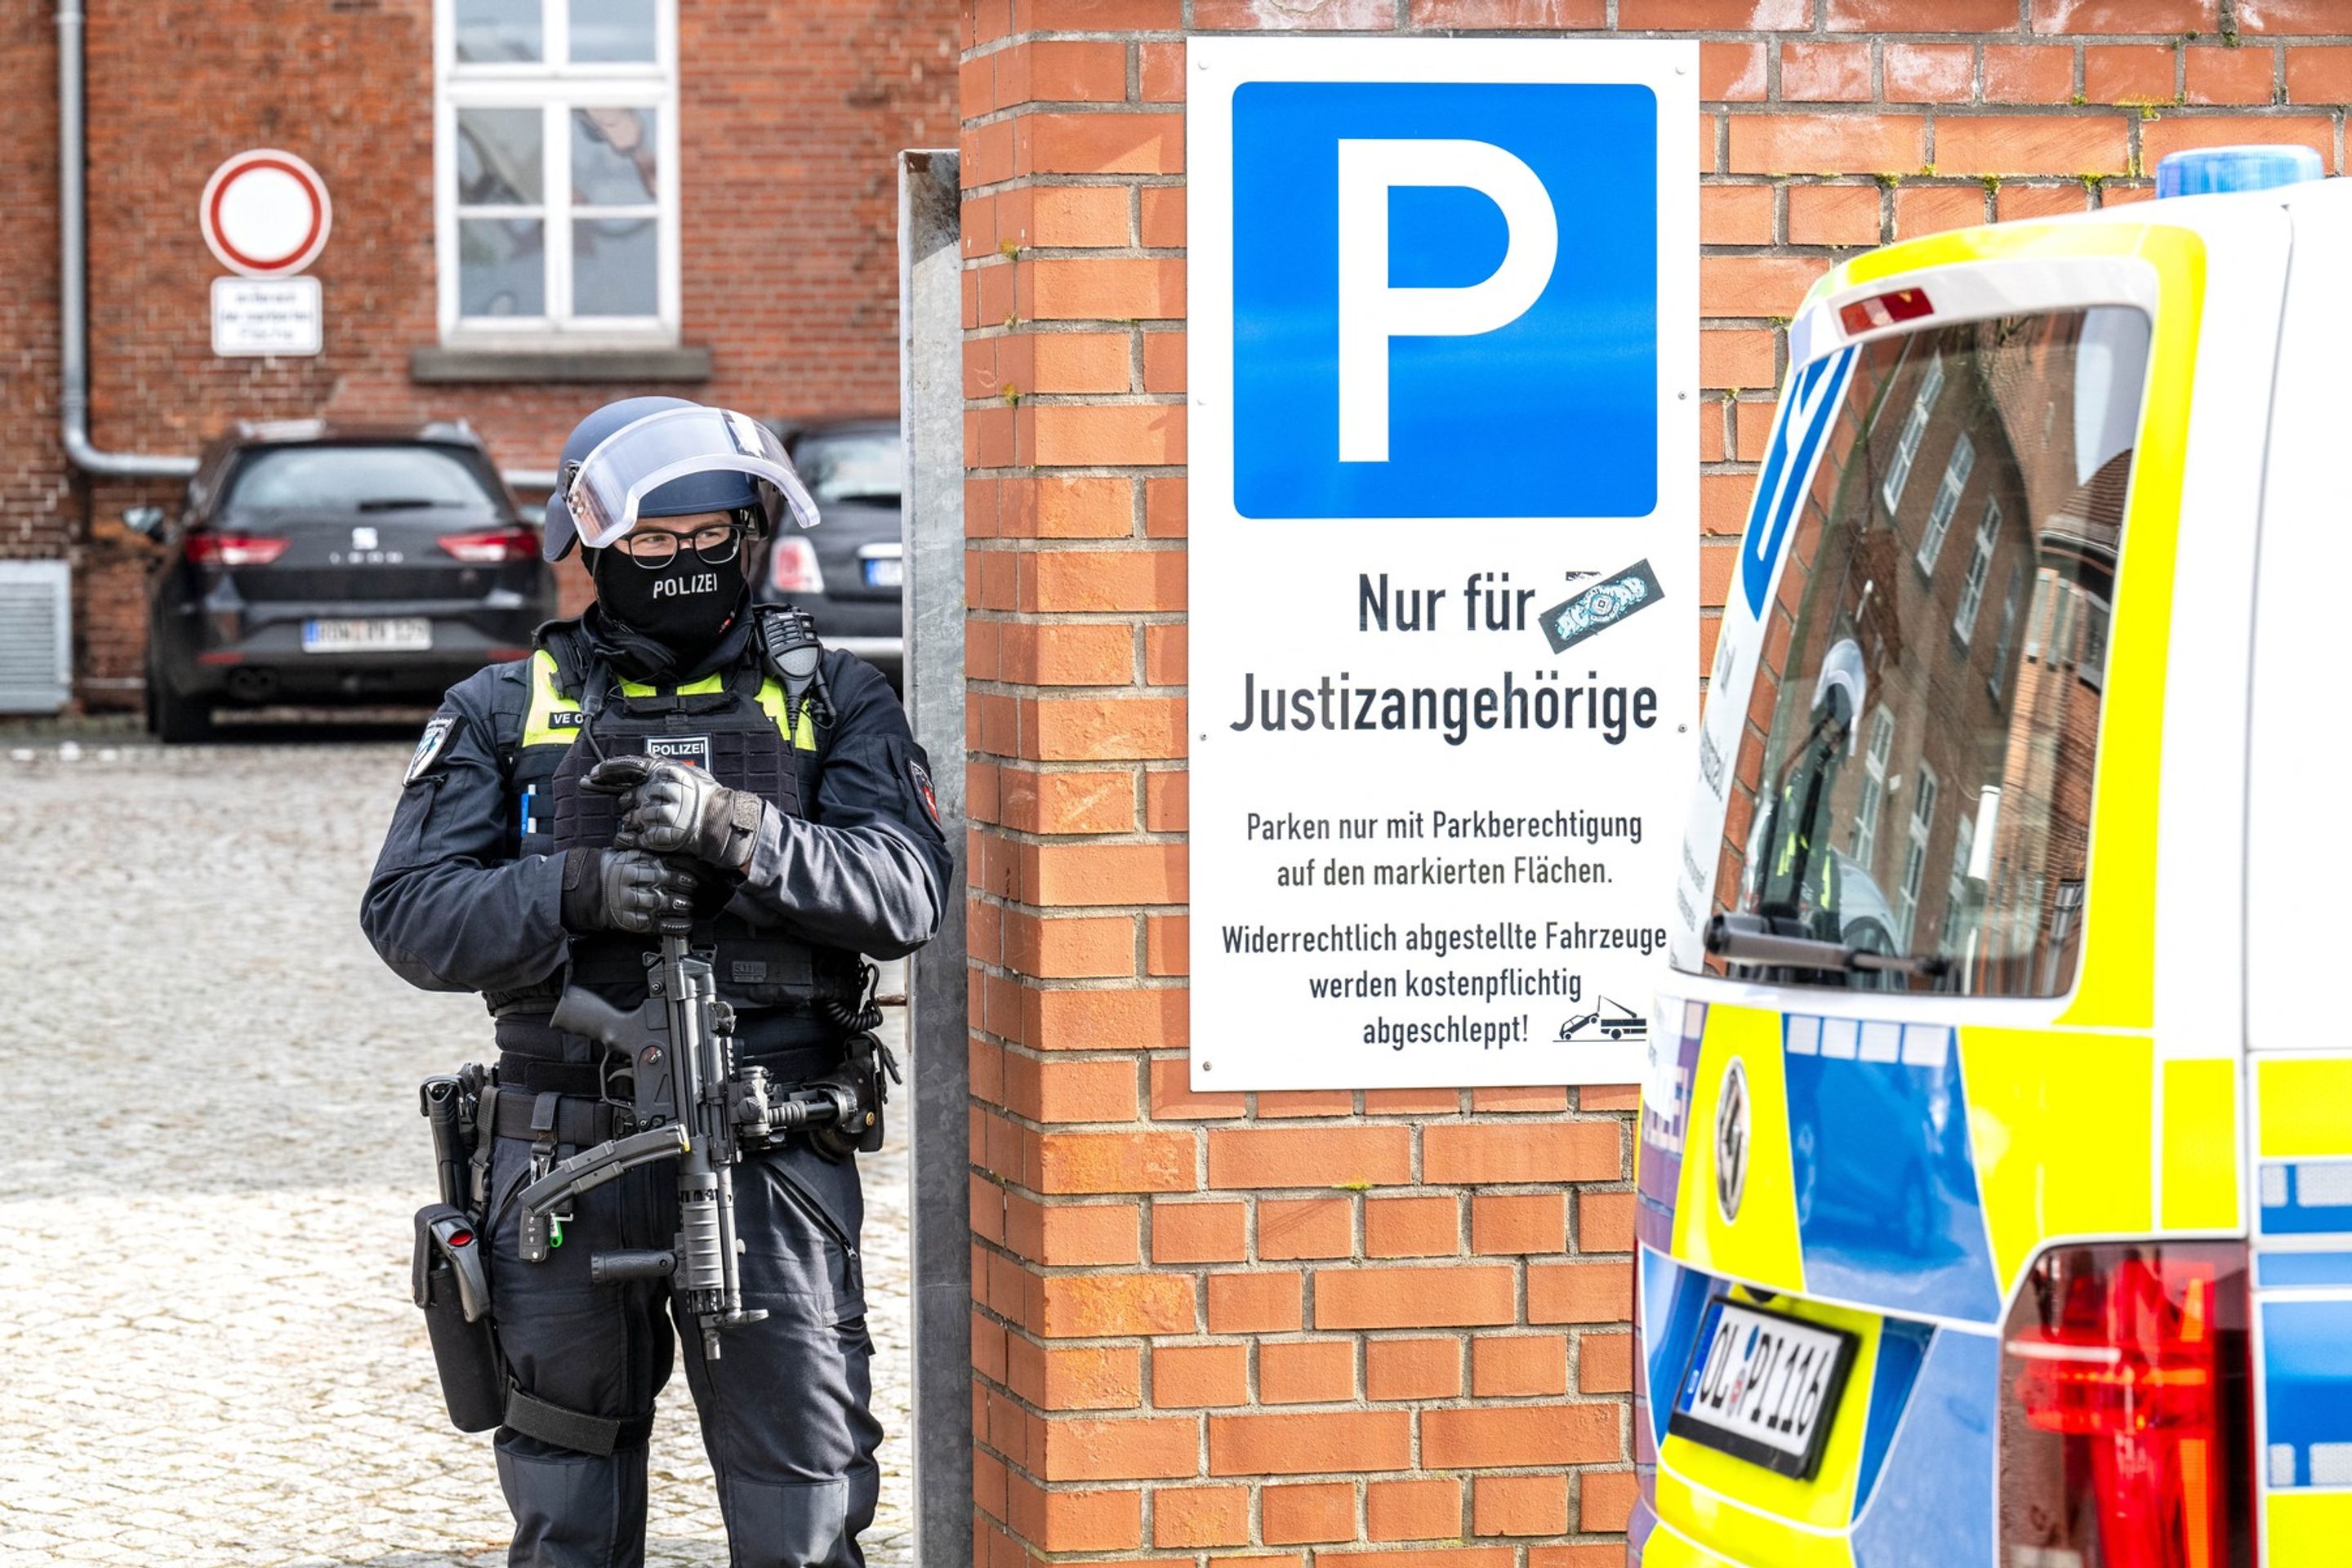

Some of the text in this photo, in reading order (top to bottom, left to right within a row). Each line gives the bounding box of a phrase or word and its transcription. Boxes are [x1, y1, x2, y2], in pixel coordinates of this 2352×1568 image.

[1339, 138, 1559, 462] P
[653, 572, 718, 599] POLIZEI
[1359, 573, 1446, 631] Nur
[1463, 572, 1535, 631] für
[554, 713, 571, 724] VE
[1229, 670, 1657, 746] Justizangehörige
[653, 742, 704, 755] POLIZEI
[1248, 809, 1642, 845] Parken nur mit Parkberechtigung
[1277, 856, 1612, 887] auf den markierten Flächen.
[1222, 921, 1666, 958] Widerrechtlich abgestellte Fahrzeuge
[1309, 968, 1581, 1004] werden kostenpflichtig
[1363, 1014, 1528, 1051] abgeschleppt!
